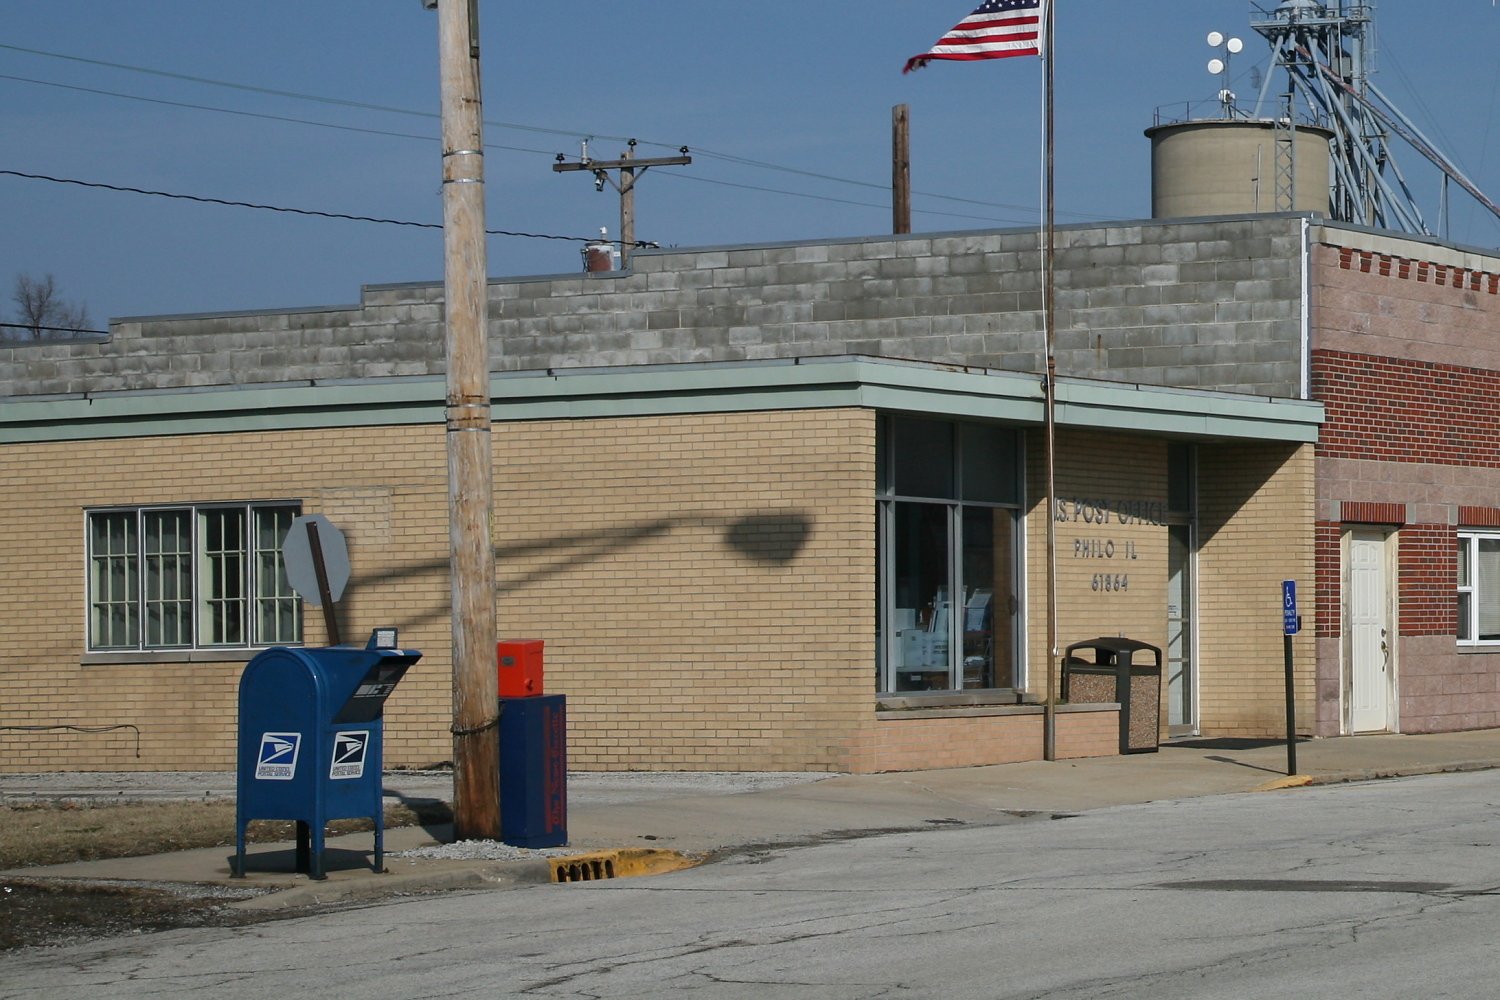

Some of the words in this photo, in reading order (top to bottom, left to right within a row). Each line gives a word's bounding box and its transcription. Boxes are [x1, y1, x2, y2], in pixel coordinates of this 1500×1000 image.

[1074, 498, 1109, 524] POST
[1117, 500, 1168, 526] OFFICE
[1074, 539, 1115, 558] PHILO
[1125, 541, 1137, 559] IL
[1092, 573, 1128, 592] 61864
